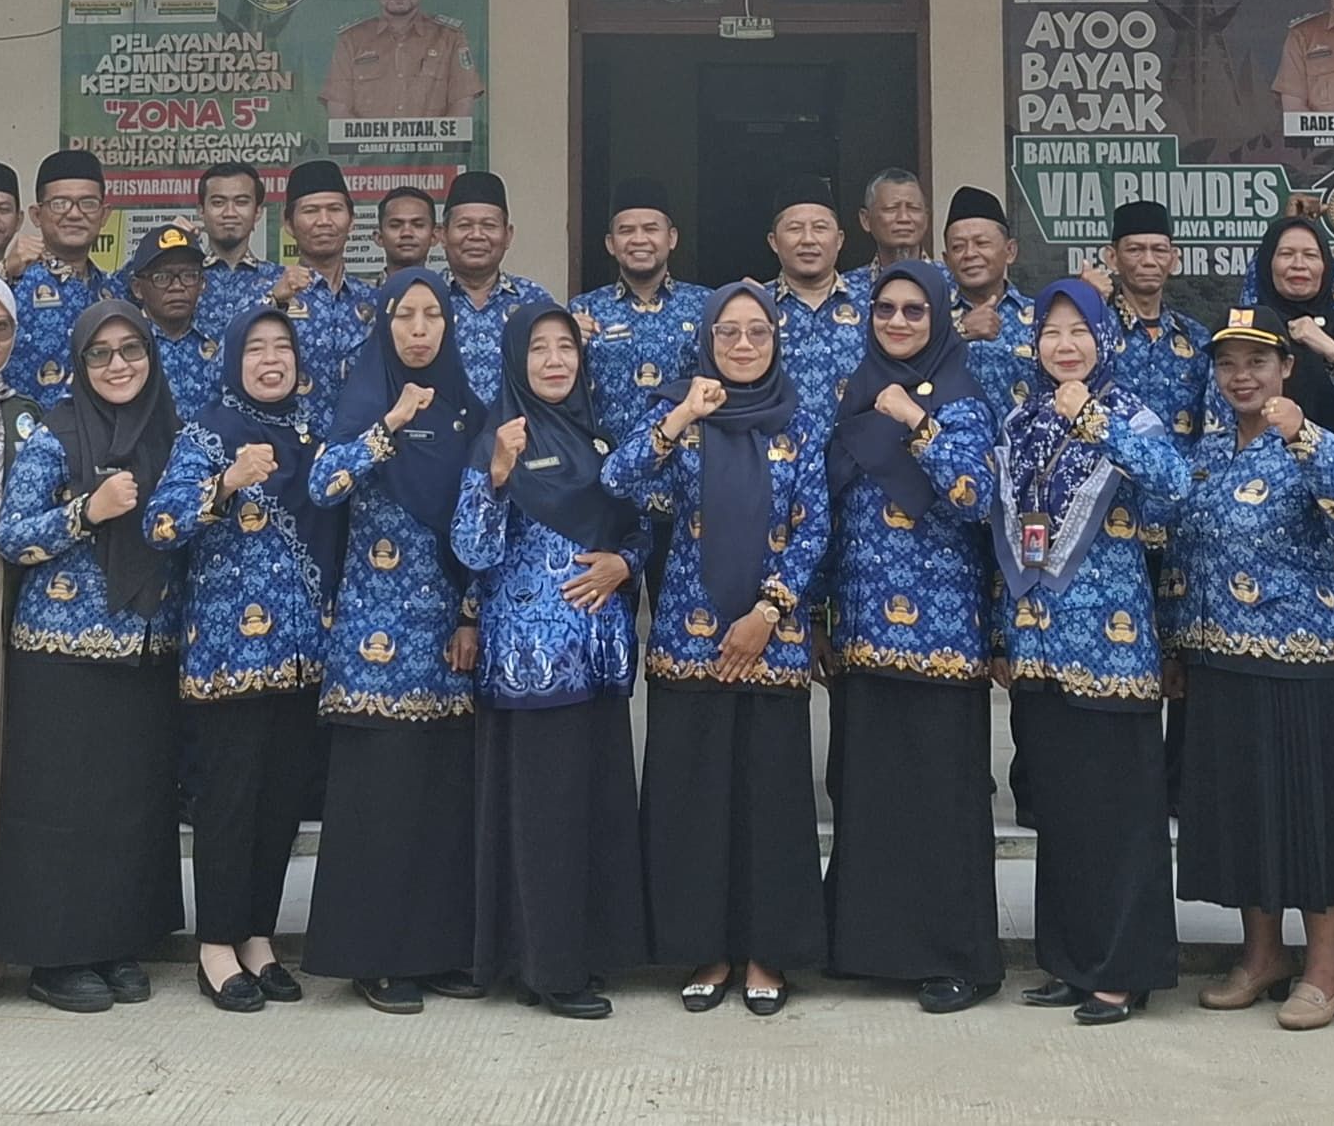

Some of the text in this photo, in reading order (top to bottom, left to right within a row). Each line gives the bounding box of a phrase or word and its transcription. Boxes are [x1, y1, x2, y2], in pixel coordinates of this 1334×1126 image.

[1025, 10, 1157, 50] AYOO
[110, 32, 263, 54] PELAYANAN
[95, 52, 279, 74] ADMINISTRASI
[1021, 51, 1162, 92] BAYAR
[80, 72, 292, 95] KEPENDUDUKAN
[104, 96, 269, 131] "ZONA 5"
[1017, 93, 1166, 133] PAJAK
[344, 120, 457, 138] RADEN PATAH, SE
[69, 132, 302, 151] DI KANTOR KECAMATAN
[357, 142, 443, 153] CAMAT PASIR SAKTI
[97, 149, 290, 165] ABUHAN MARINGGAI
[1023, 141, 1161, 165] BAYAR PAJAK
[105, 177, 191, 195] PERSYARATAN
[1037, 171, 1279, 218] VIA BUMDES
[1054, 221, 1108, 238] MITRA
[1173, 221, 1211, 238] JAYA
[91, 234, 114, 253] KTP
[1068, 246, 1108, 275] DES
